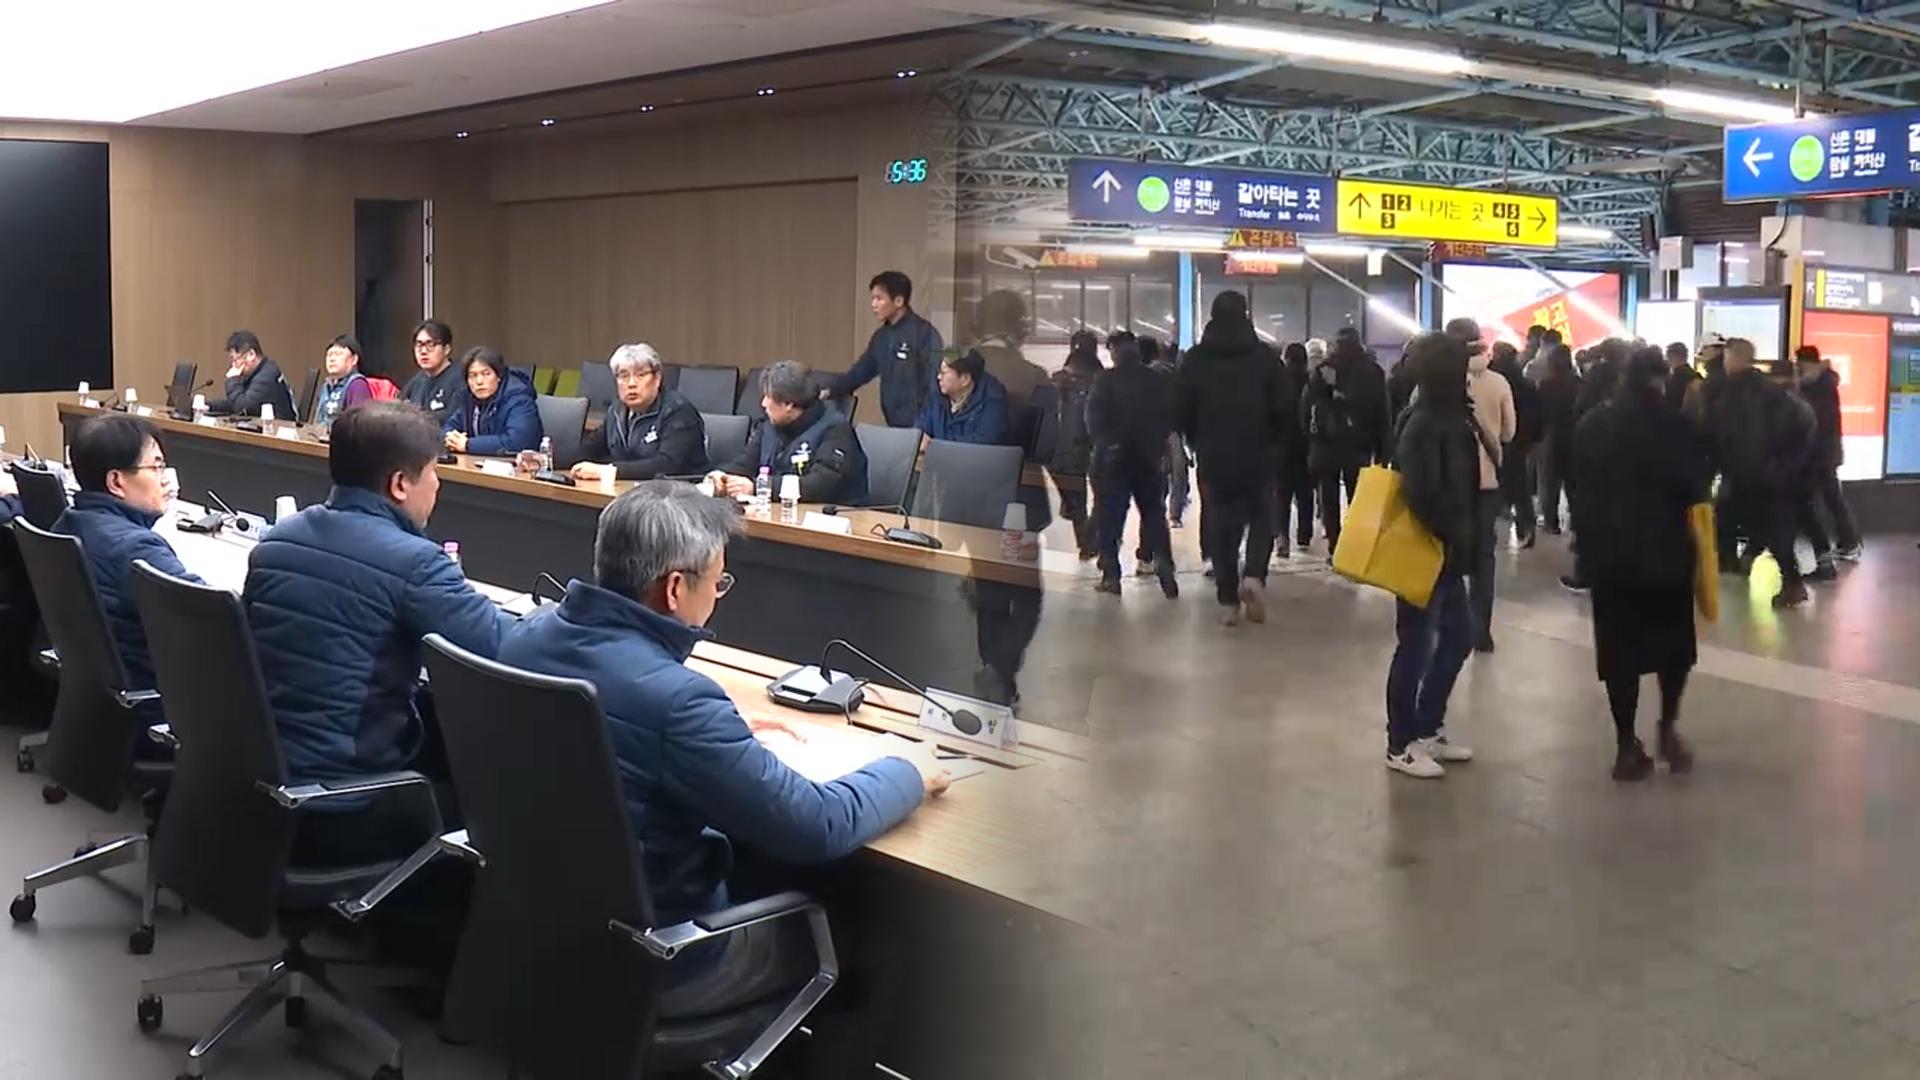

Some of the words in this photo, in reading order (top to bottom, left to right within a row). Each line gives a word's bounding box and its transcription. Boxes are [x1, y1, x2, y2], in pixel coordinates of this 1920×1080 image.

[1238, 182, 1299, 208] 갈아타는
[1239, 208, 1271, 220] Transfer
[1420, 199, 1461, 220] 나가는
[1472, 203, 1484, 222] 곳
